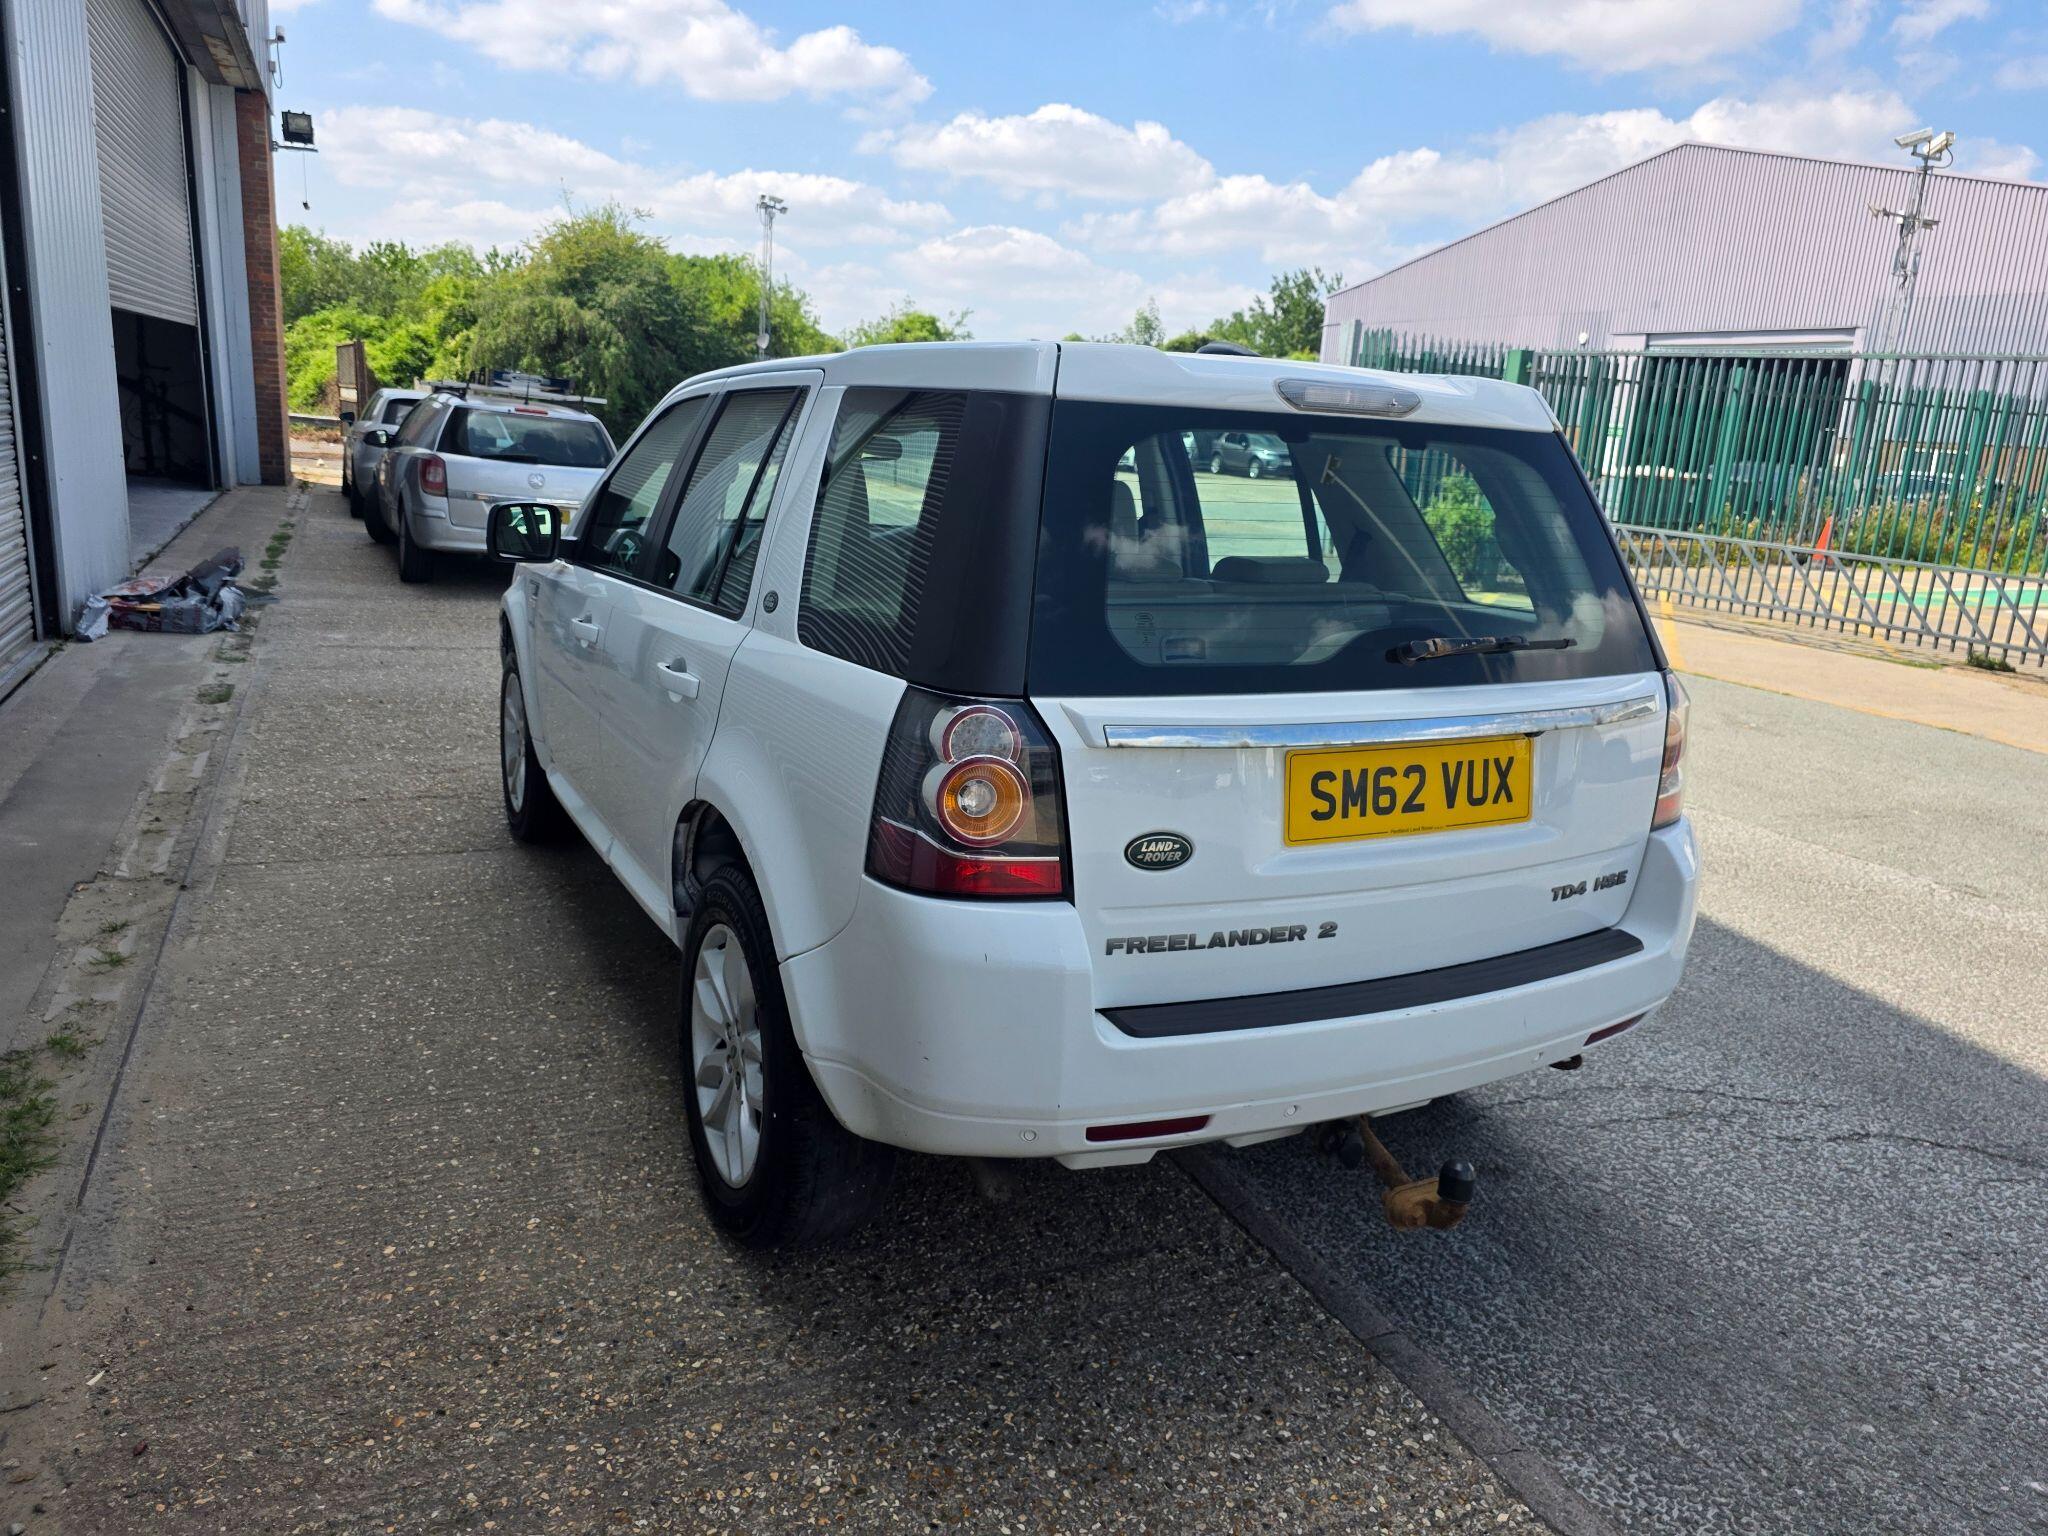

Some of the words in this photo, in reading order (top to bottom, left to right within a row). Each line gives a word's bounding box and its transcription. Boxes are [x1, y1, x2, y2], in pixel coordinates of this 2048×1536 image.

[1310, 764, 1427, 822] SM62
[1441, 756, 1515, 810] VUX
[1141, 841, 1174, 852] LAND
[1143, 851, 1182, 862] ROVER
[1551, 880, 1587, 902] TD4
[1593, 869, 1629, 892] HSE
[1105, 924, 1308, 956] FREELANDER
[1317, 921, 1339, 939] 2
